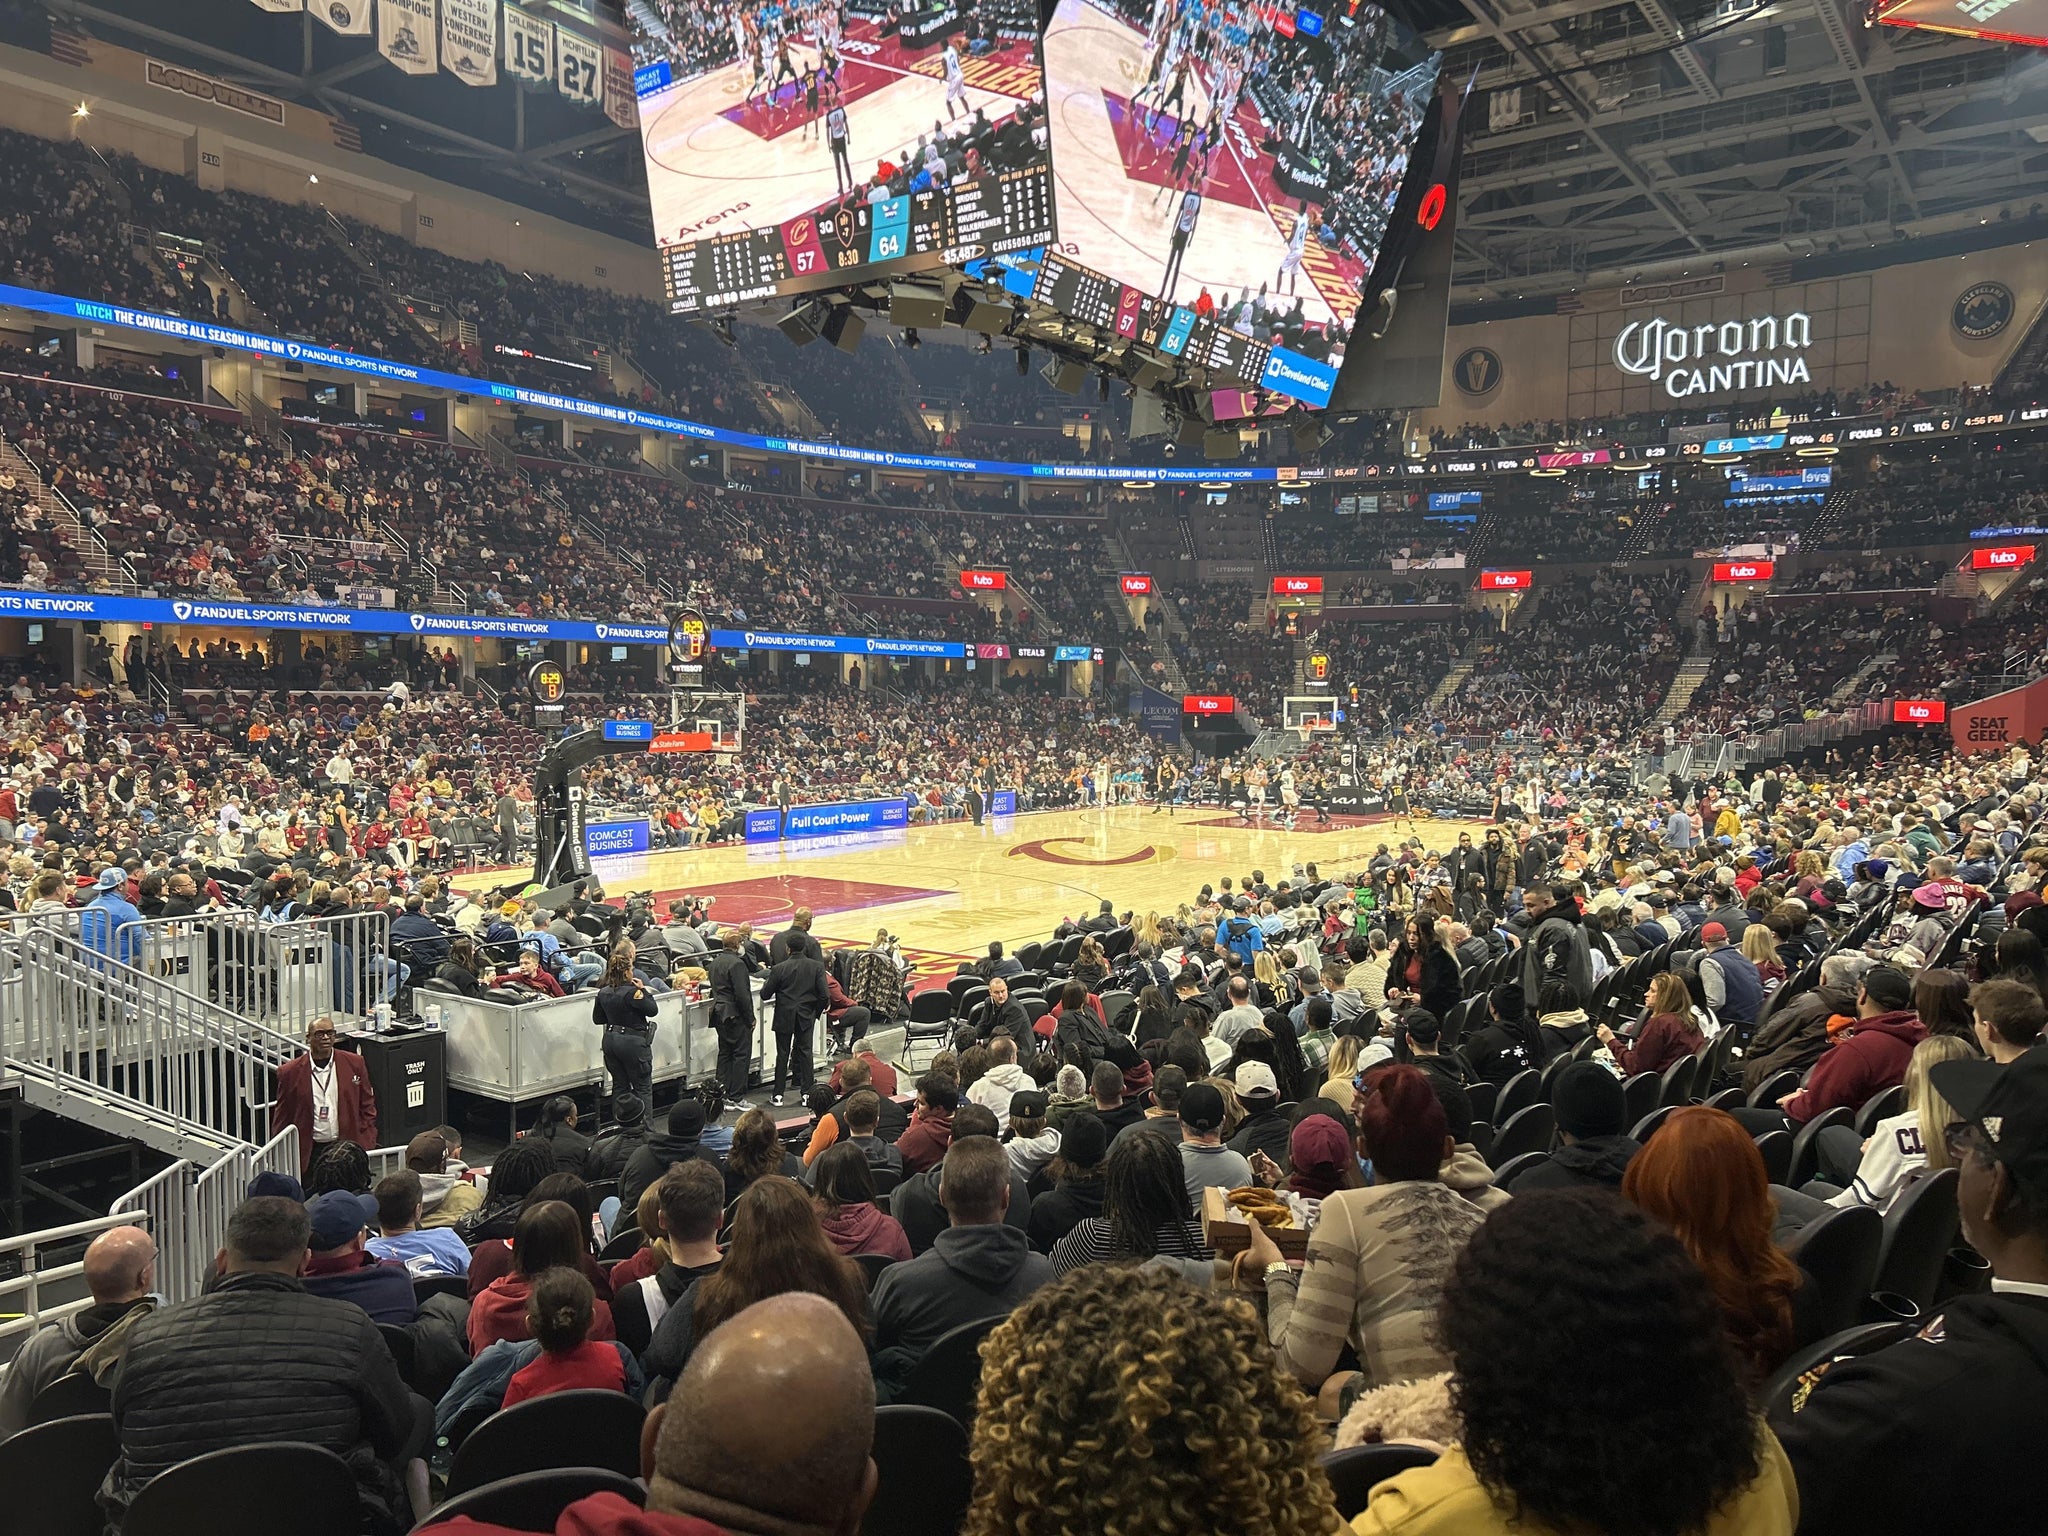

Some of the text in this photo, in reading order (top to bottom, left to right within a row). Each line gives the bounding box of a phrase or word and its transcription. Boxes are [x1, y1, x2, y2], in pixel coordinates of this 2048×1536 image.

[450, 5, 487, 29] WESTERN
[444, 18, 493, 45] CONFERENCE
[447, 32, 492, 58] CHAMPIONS
[514, 31, 545, 76] 15
[563, 54, 597, 97] 27
[203, 153, 220, 166] 210
[858, 210, 866, 226] 8
[819, 220, 834, 234] 3Q
[879, 234, 899, 256] 64
[959, 232, 981, 244] MILLER
[671, 243, 696, 253] CAVALIERS
[943, 245, 976, 265] $5,487
[993, 231, 1052, 252] CAVS5050.COM
[672, 251, 696, 262] GARLAND
[797, 250, 815, 271] 57
[838, 249, 858, 267] 8:30
[674, 270, 691, 279] ALLEN
[676, 286, 701, 296] MITCHELL
[739, 285, 777, 300] RAFFLE
[1961, 287, 2005, 304] CLEVELAND
[75, 302, 285, 354] WATCH THE CAVALIERS ALL SEASON LONG ON
[1120, 314, 1134, 331] 57
[1961, 320, 2002, 336] MONSTERS
[1167, 333, 1180, 350] 64
[1612, 311, 1814, 381] Corona
[302, 349, 418, 379] FANDUEL SPORTS NETWORK
[1280, 364, 1330, 392] Cleveland Clinic
[1665, 356, 1810, 398] CANTINA
[491, 385, 626, 421] WATCH THE CAVALIERS ALL SEASON LONG ON
[637, 415, 715, 437] FANDUEL SPORTS NETWORK
[766, 439, 884, 462] WATCH THE CAVALIERS ALL SEASON LONG ON
[1334, 468, 1359, 477] $5,487
[1408, 465, 1425, 473] TOL
[1430, 464, 1437, 473] 4
[1448, 462, 1476, 471] FOULS
[1498, 460, 1518, 469] FG%
[1522, 458, 1535, 468] 40
[1582, 452, 1595, 463] 57
[1619, 451, 1625, 459] 8
[1645, 447, 1666, 458] 8:29
[1683, 444, 1700, 455] 3Q
[1718, 442, 1733, 452] 64
[1790, 434, 1814, 445] FG%
[1819, 433, 1834, 443] 46
[1849, 427, 1883, 440] FOULS
[1890, 426, 1899, 436] 2
[1913, 423, 1934, 433] TOL
[1941, 421, 1950, 430] 6
[1964, 417, 1986, 426] 4:56
[1987, 414, 2003, 424] PM
[894, 457, 977, 469] FANDUEL SPORTS NETWORK
[1033, 466, 1156, 478] WATCH THE CAVALIERS ALL SEASON LONG ON
[352, 543, 363, 551] LOS
[1990, 551, 2016, 564] fubo
[1730, 565, 1757, 577] fubo
[973, 574, 993, 586] fubo
[1126, 580, 1147, 591] fubo
[1287, 580, 1308, 591] fubo
[1495, 575, 1518, 585] fubo
[0, 597, 94, 612] RTS NETWORK
[194, 605, 351, 625] FANDUEL SPORTS NETWORK
[426, 618, 549, 634] FANDUEL SPORTS NETWORK
[608, 627, 644, 638] FANDUEL
[683, 620, 703, 633] 8:29
[690, 639, 701, 656] 8
[755, 636, 836, 647] FANDUEL SPORTS NETWORK
[875, 642, 945, 653] FANDUEL SPORTS NETWORK
[996, 648, 1067, 659] 6 STEALS 6
[540, 672, 560, 684] 8:29
[548, 684, 557, 698] 8
[1143, 706, 1178, 716] LECOM
[1198, 700, 1218, 710] fubo
[1909, 707, 1929, 718] fubo
[1970, 717, 2008, 729] SEAT
[1967, 730, 2009, 742] GEEK
[751, 819, 776, 827] COMCAST
[791, 811, 870, 829] Full Court Power
[571, 802, 585, 870] Cleveland Clinic
[589, 829, 634, 840] COMCAST
[751, 825, 776, 833] BUSINESS
[589, 839, 633, 851] BUSINESS
[1941, 884, 1963, 894] JAMES
[1946, 896, 1967, 919] 23
[1273, 987, 1288, 1003] 10
[405, 1060, 425, 1070] TRASH
[407, 1066, 424, 1075] ONLY
